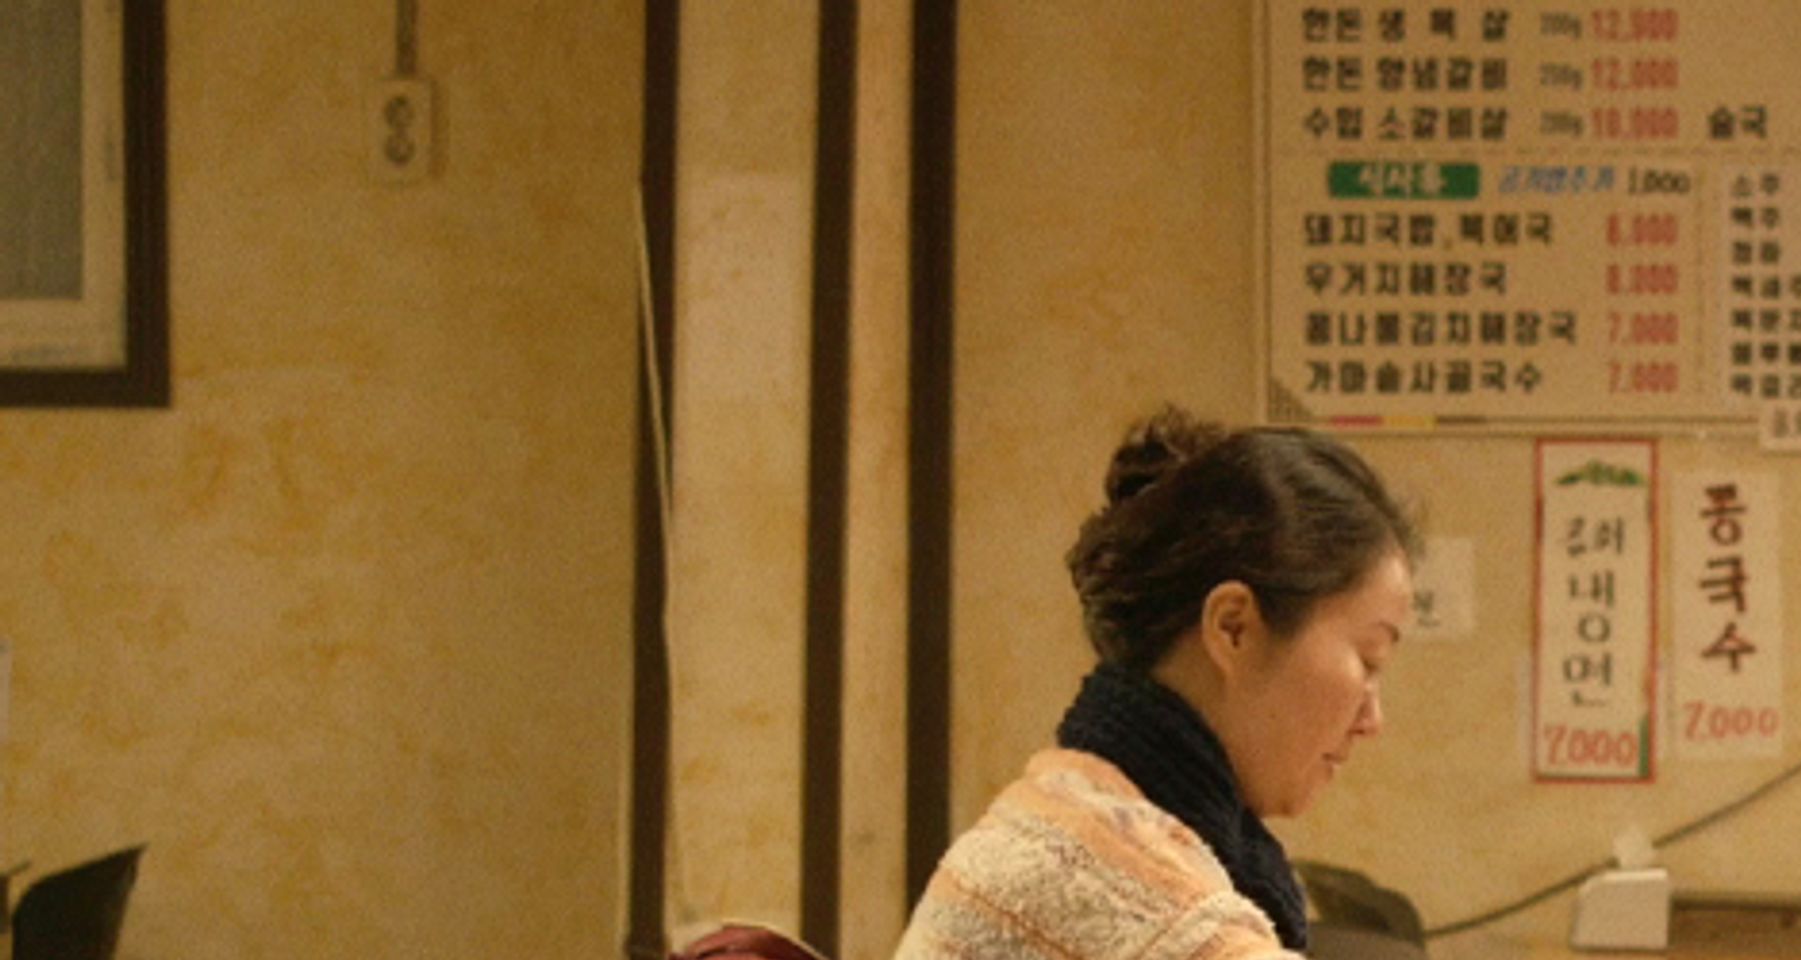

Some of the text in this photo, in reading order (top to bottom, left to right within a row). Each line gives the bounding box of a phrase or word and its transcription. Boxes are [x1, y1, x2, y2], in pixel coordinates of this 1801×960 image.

[1304, 106, 1363, 140] 수입
[1305, 261, 1505, 296] 우거지해장국
[1305, 311, 1575, 346] 콩나물김치해장국
